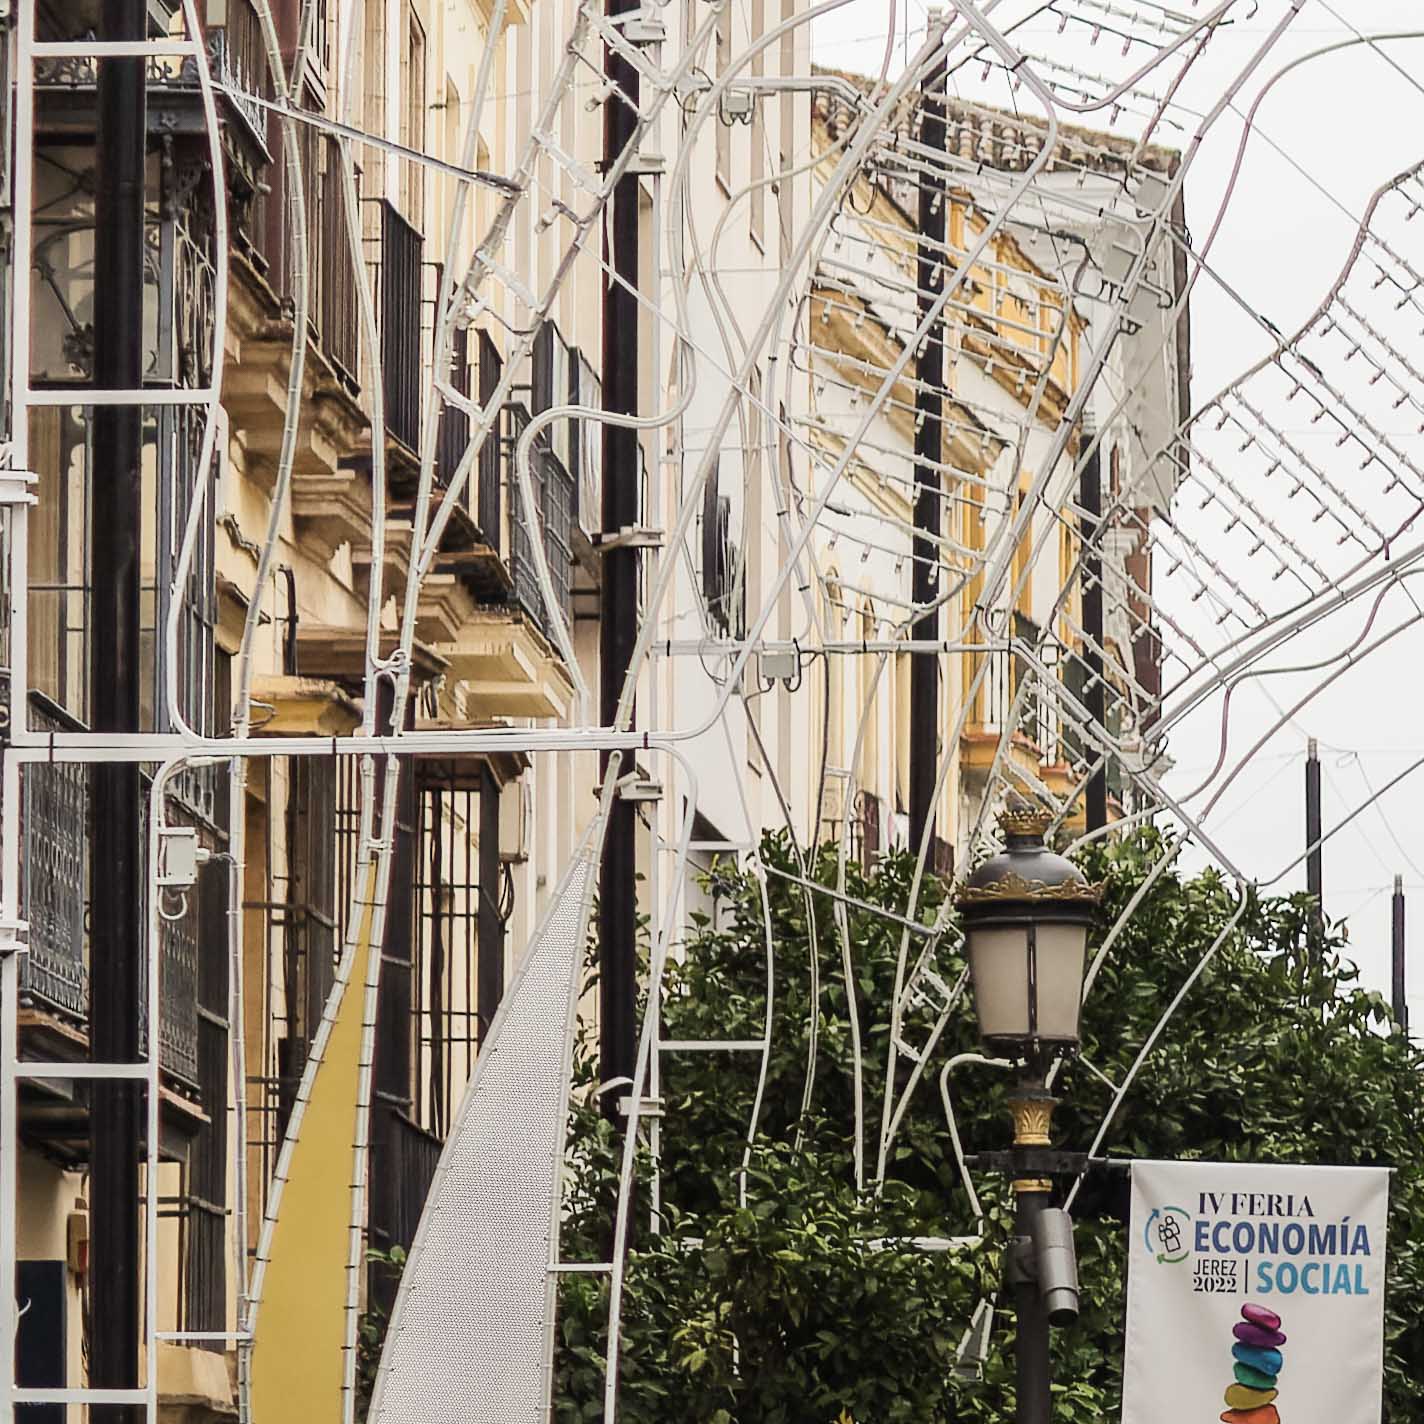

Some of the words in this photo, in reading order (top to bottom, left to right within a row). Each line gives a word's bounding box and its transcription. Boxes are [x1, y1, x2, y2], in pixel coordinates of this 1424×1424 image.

[1199, 1192, 1226, 1215] IV
[1231, 1193, 1315, 1217] FERIA
[1193, 1216, 1371, 1256] ECONOMÍA
[1193, 1259, 1237, 1276] JEREZ
[1256, 1261, 1370, 1296] SOCIAL
[1193, 1276, 1237, 1293] 2022
